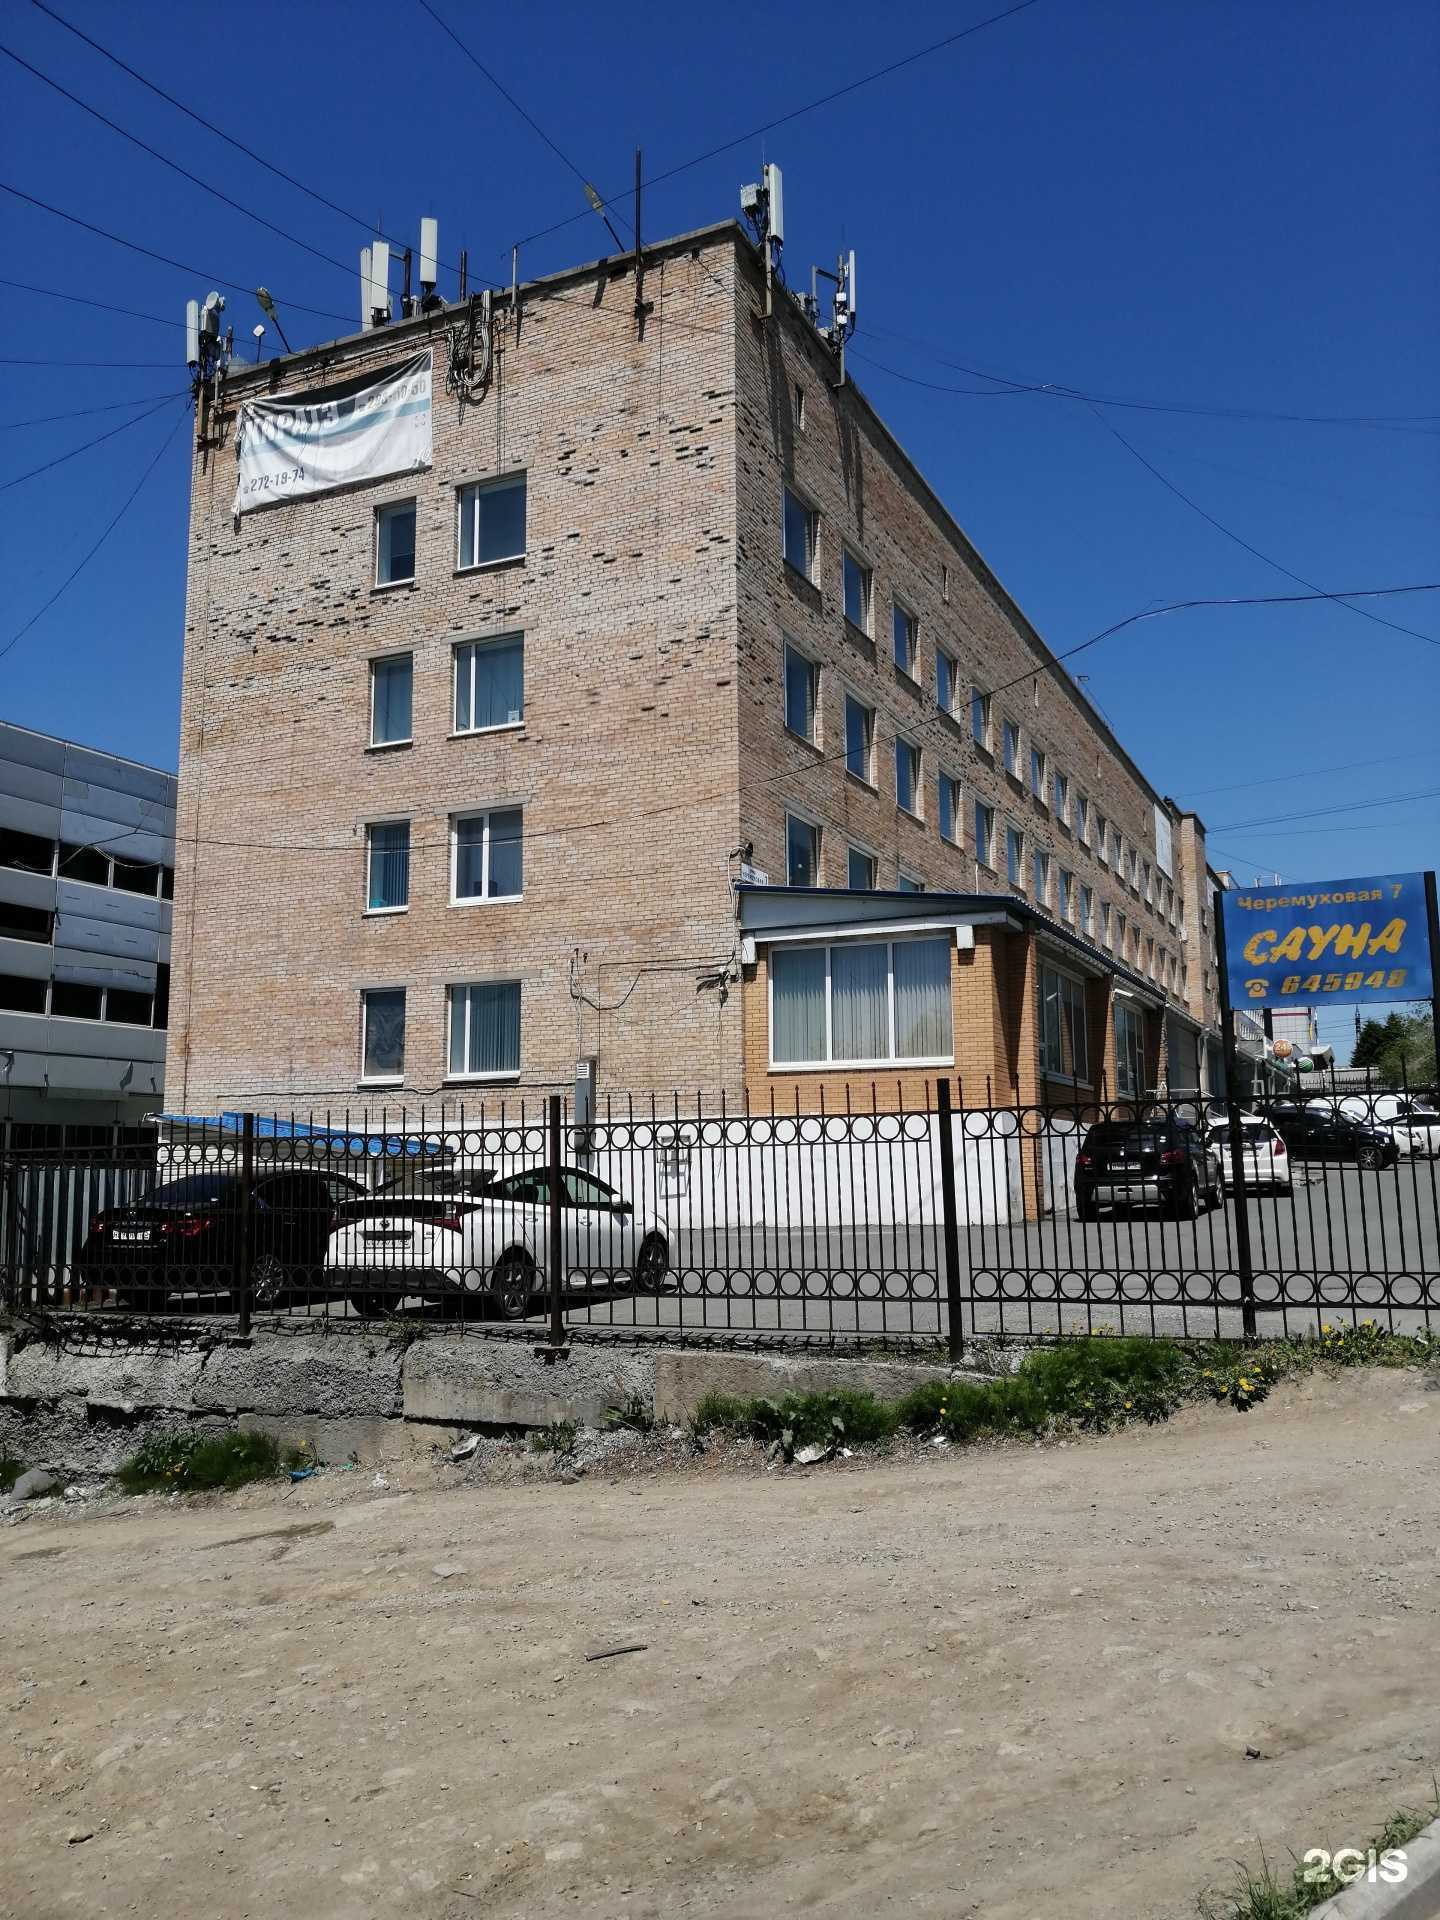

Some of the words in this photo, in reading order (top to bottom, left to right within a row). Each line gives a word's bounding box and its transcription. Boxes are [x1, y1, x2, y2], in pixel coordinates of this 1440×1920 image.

[1237, 889, 1383, 912] Черемуховая
[1392, 883, 1403, 899] 7
[1243, 917, 1408, 966] САУНА
[1280, 969, 1408, 994] 645948
